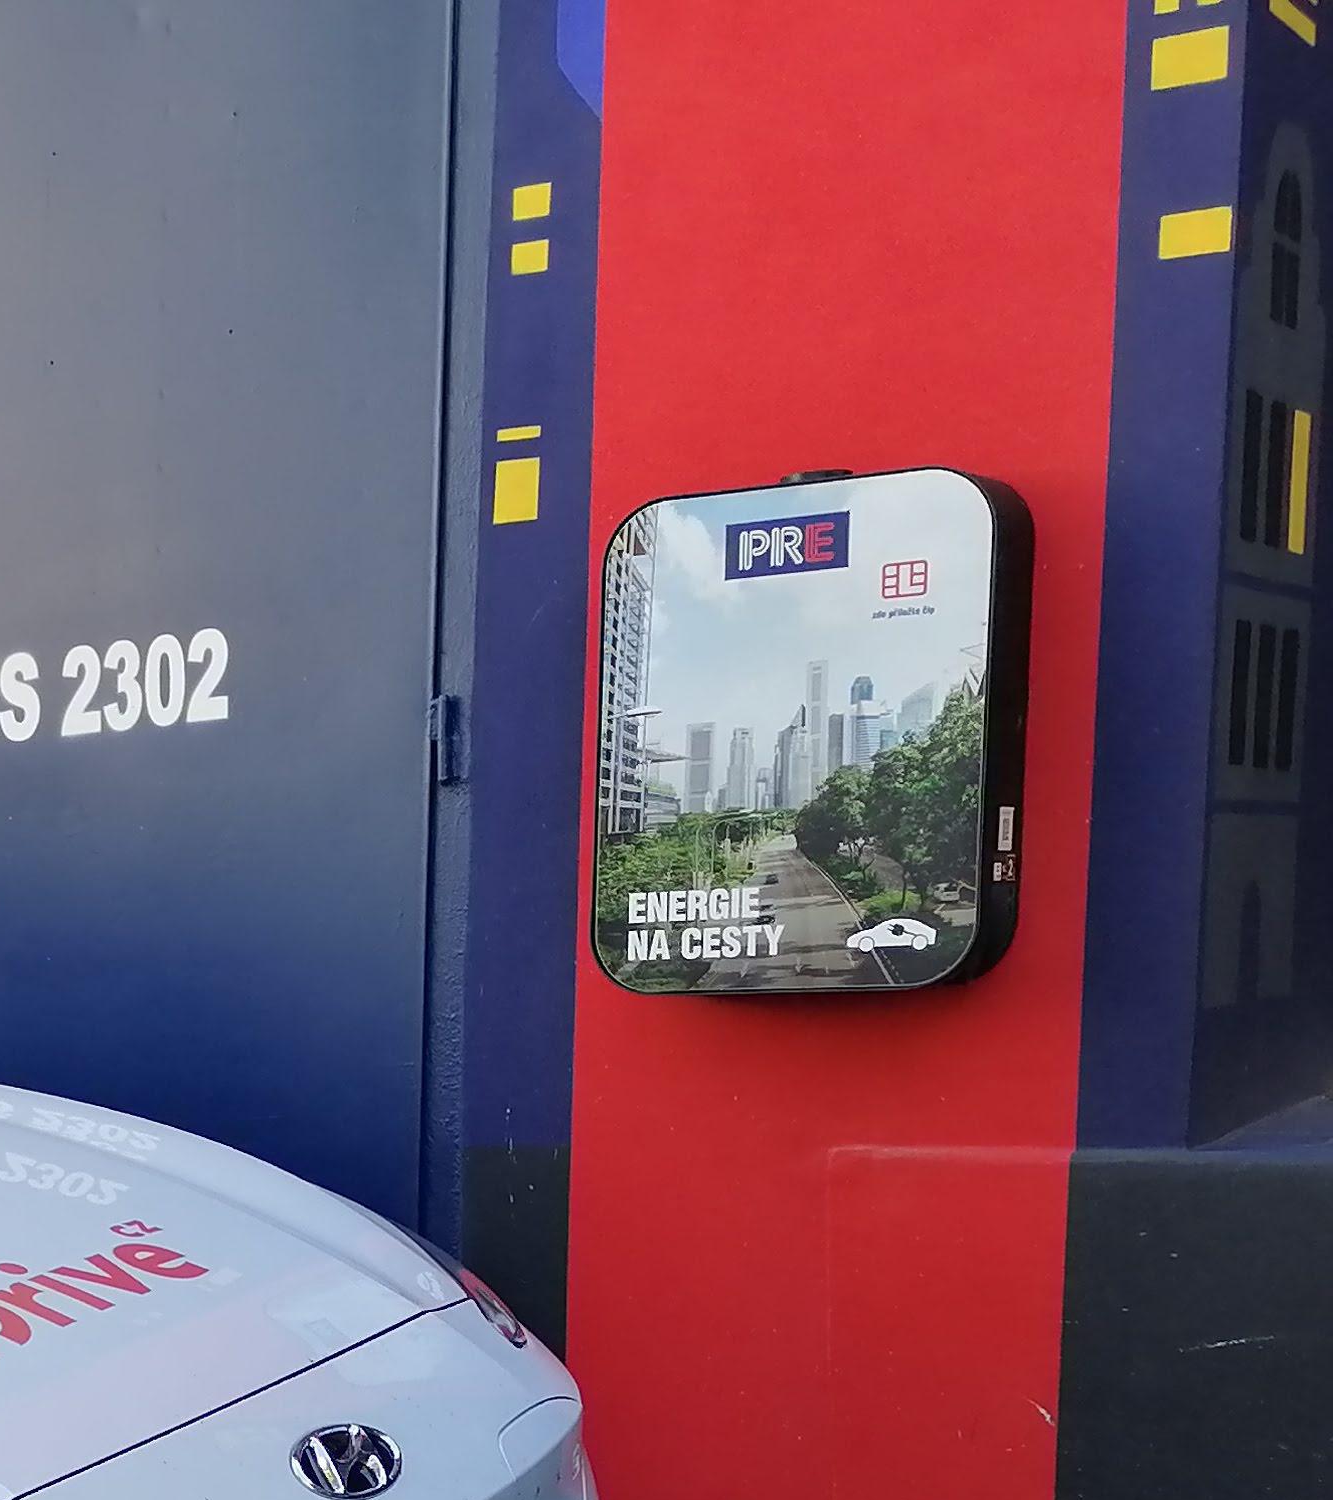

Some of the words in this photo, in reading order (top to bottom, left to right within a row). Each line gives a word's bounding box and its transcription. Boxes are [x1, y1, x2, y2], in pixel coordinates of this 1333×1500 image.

[737, 521, 836, 571] PRE
[61, 627, 230, 736] 2302
[627, 887, 760, 924] ENERGIE
[627, 929, 671, 961] NA
[680, 924, 785, 960] CESTY
